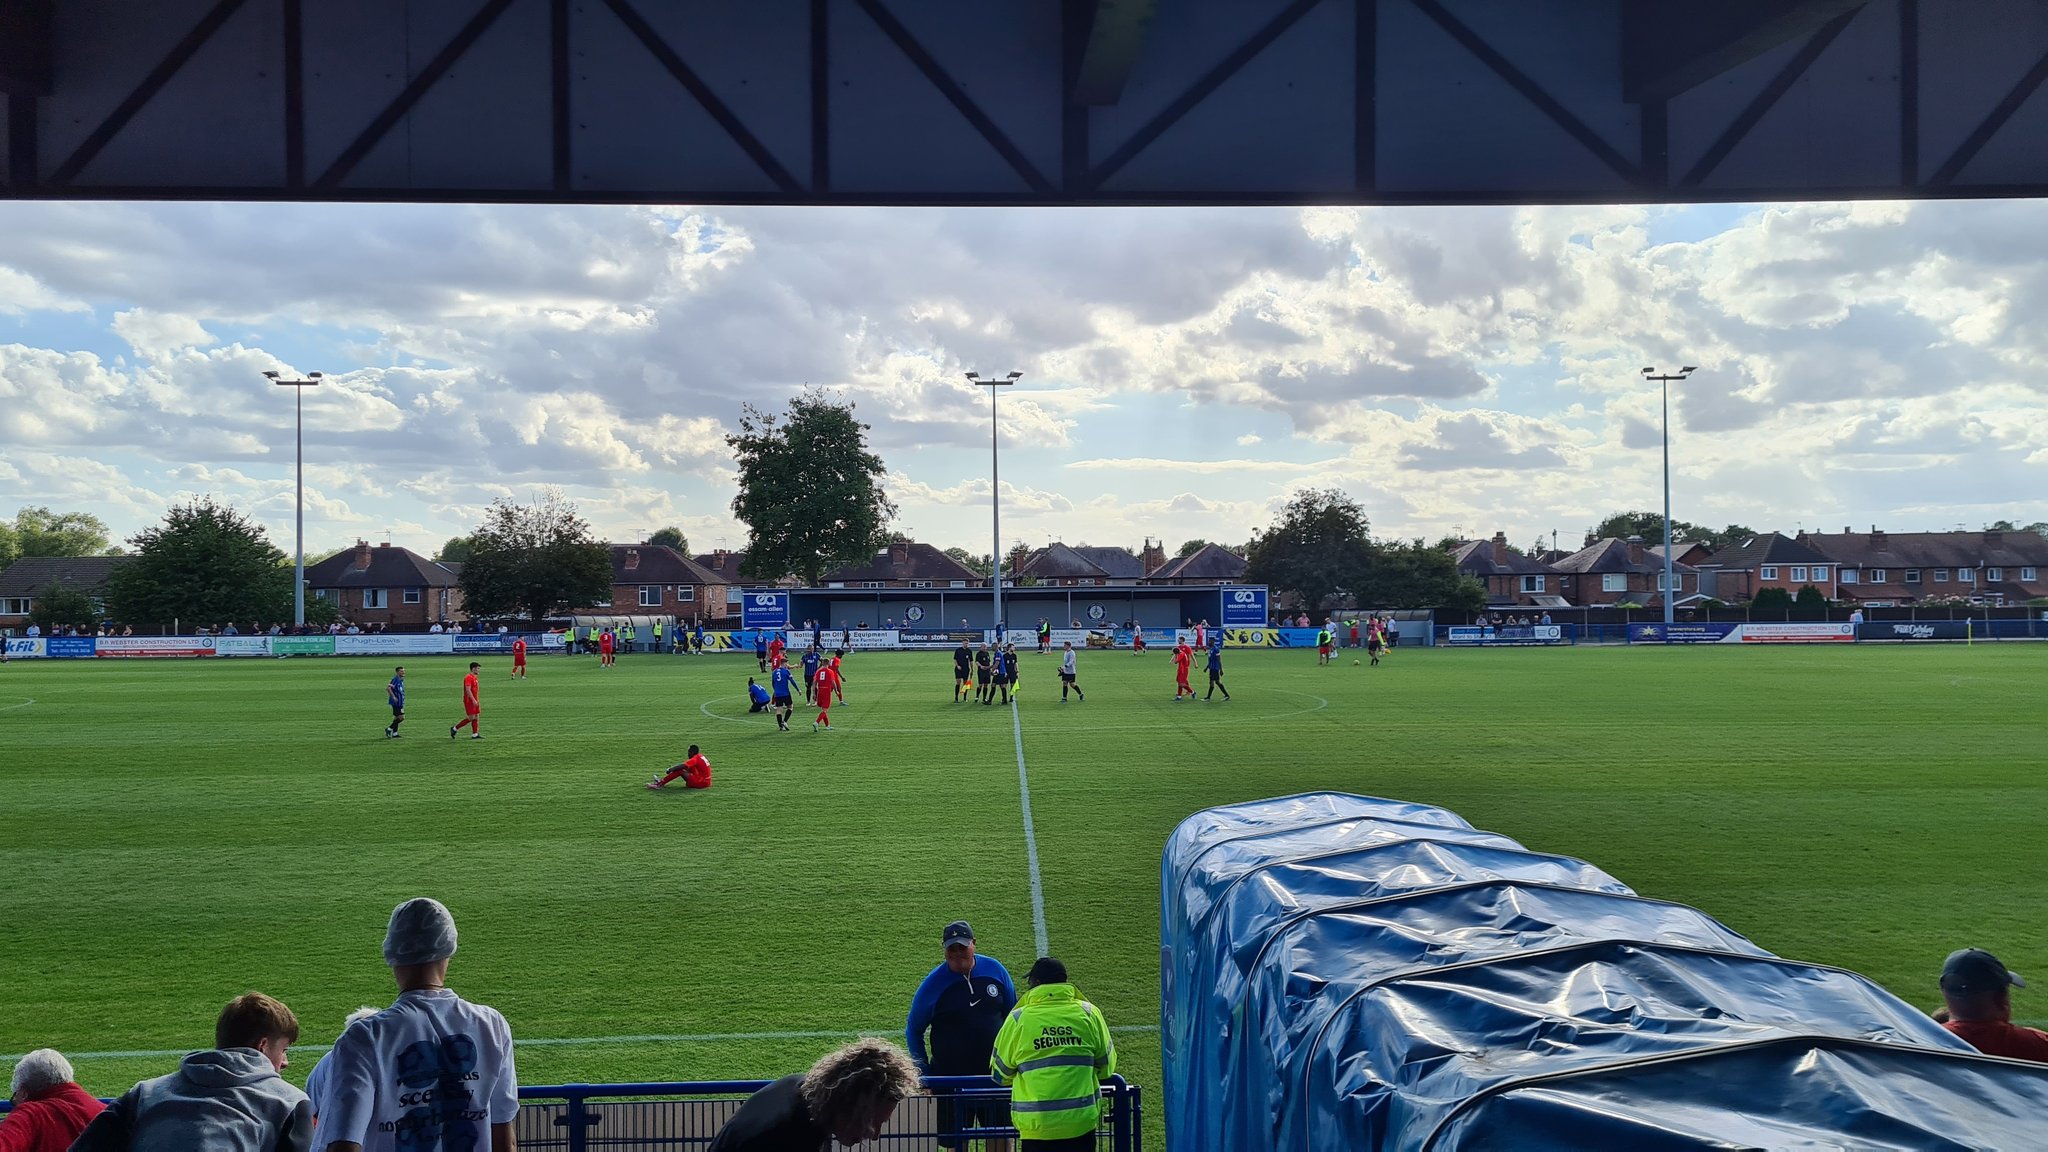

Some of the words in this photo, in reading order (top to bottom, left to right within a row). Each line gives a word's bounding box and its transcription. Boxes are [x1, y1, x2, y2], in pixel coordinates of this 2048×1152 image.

[794, 632, 831, 640] Nottingam
[776, 672, 781, 681] 3
[1042, 1026, 1073, 1036] ASGS
[1033, 1036, 1082, 1050] SECURITY
